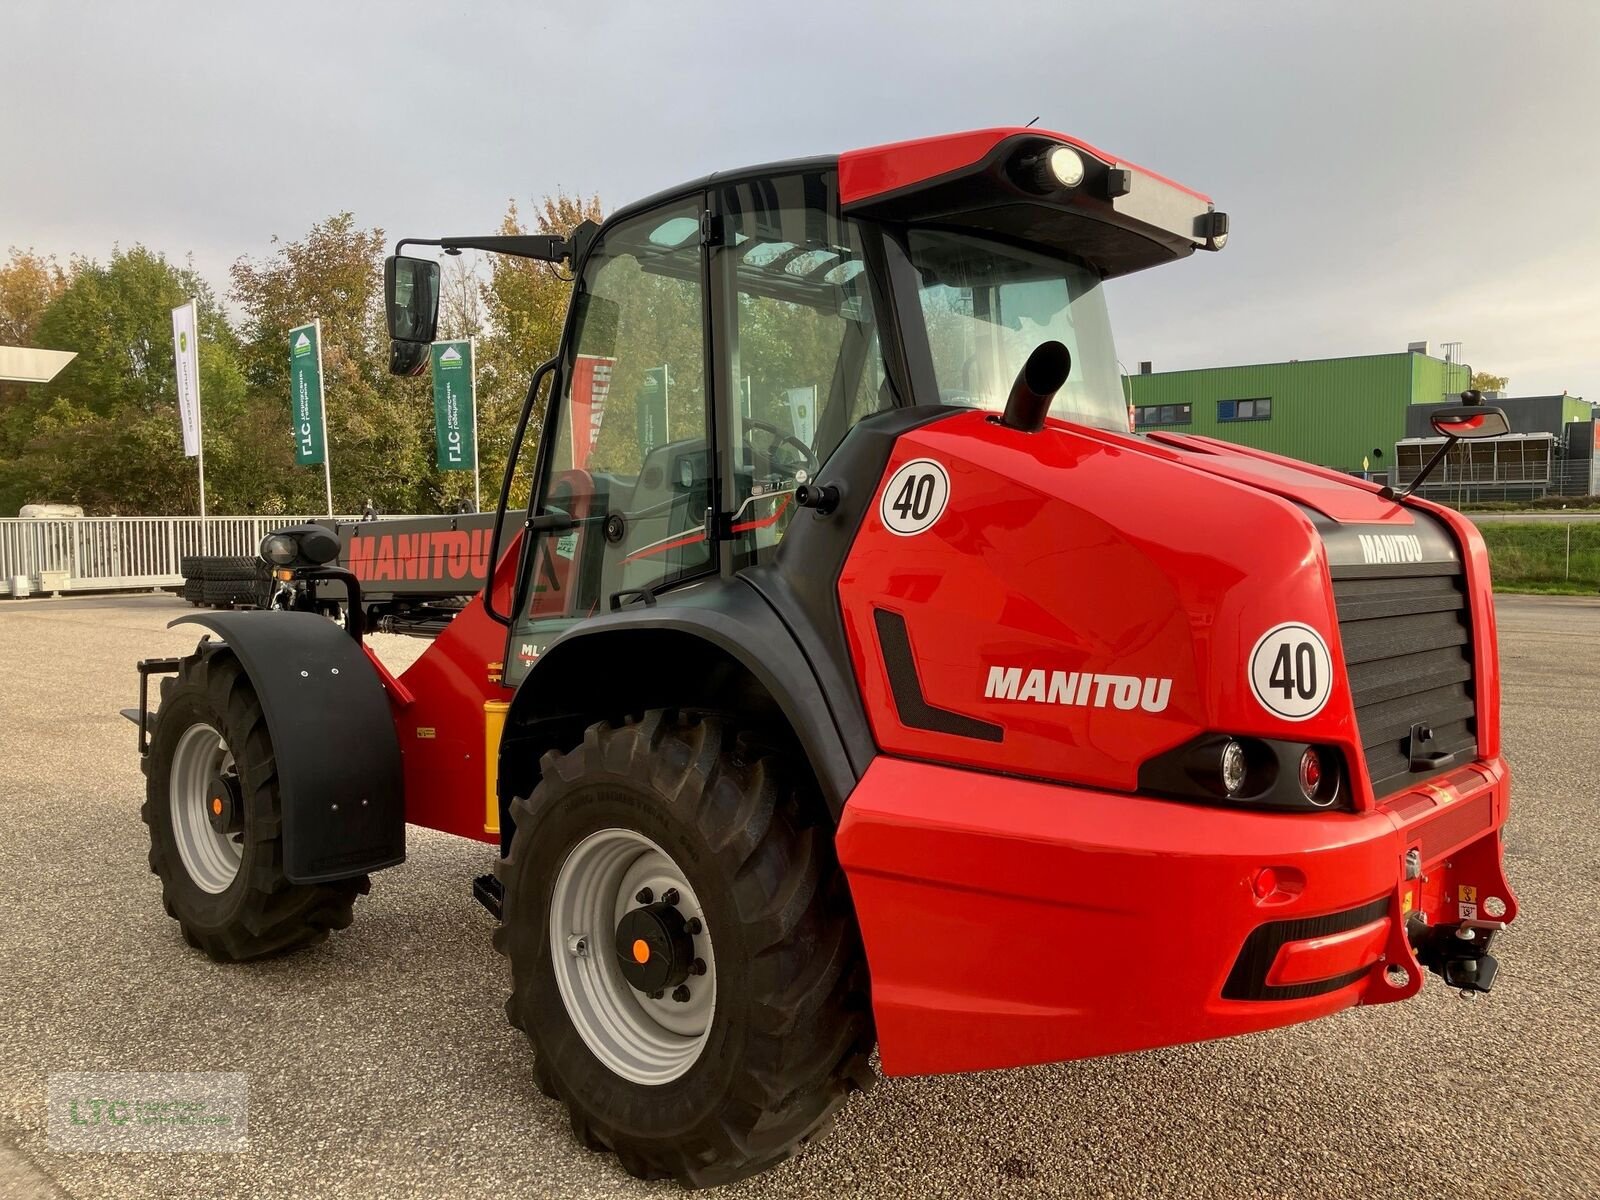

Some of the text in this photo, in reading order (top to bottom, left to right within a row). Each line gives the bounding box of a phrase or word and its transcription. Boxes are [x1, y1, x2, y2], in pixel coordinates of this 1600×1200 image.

[892, 474, 936, 521] 40
[348, 528, 494, 582] MANITOU
[1358, 534, 1423, 564] MANITOU
[521, 643, 547, 657] ML
[1269, 642, 1317, 700] 40
[984, 666, 1173, 713] MANITOU
